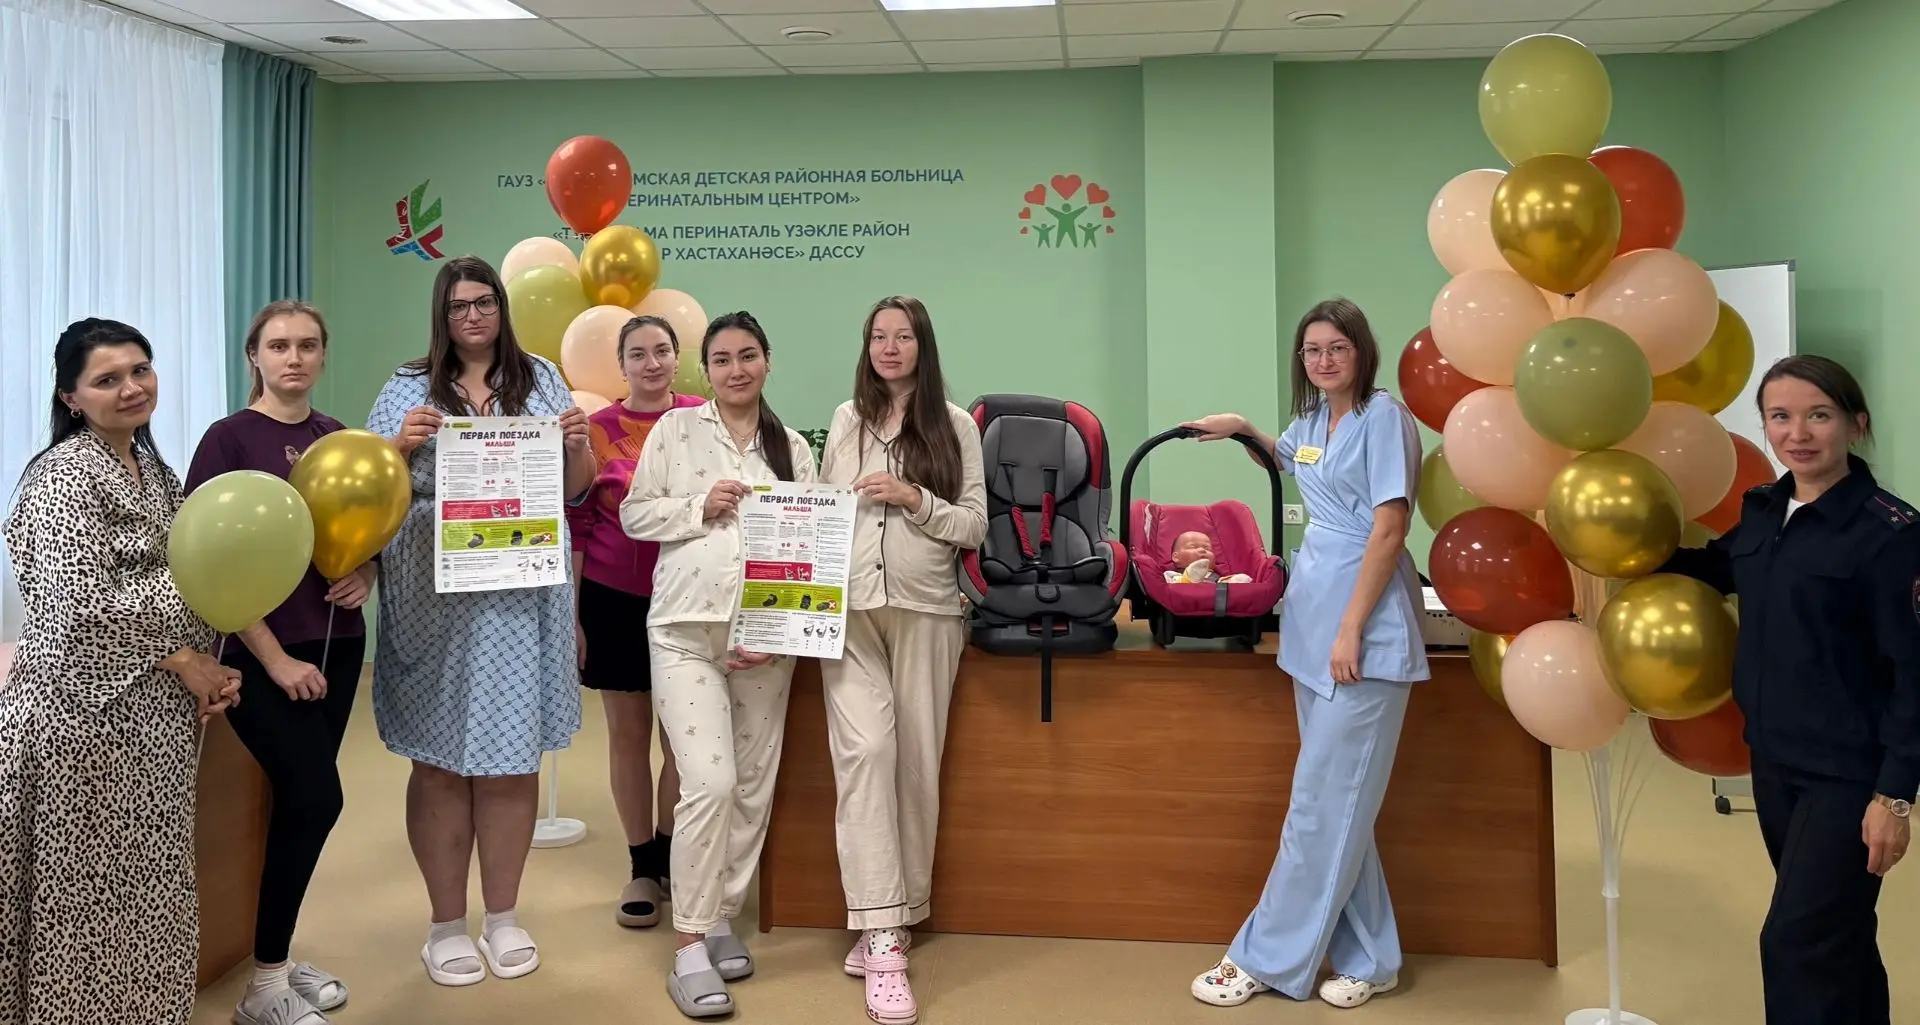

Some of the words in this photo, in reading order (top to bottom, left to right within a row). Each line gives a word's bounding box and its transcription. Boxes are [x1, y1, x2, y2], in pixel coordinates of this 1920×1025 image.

[498, 175, 533, 187] ГАУЗ
[633, 172, 690, 185] МСКАЯ
[694, 171, 770, 187] ДЕТСКАЯ
[775, 168, 866, 184] РАЙОННАЯ
[871, 169, 964, 184] БОЛЬНИЦА
[628, 193, 763, 207] ЕРИНАТАЛЬНЫМ
[768, 192, 861, 207] ЦЕНТРОМ»
[643, 226, 668, 239] МА
[673, 225, 781, 239] ПЕРИНАТАЛЬ
[785, 224, 848, 238] ҮЗӘКЛЕ
[852, 220, 910, 236] РАЙОН
[675, 246, 805, 260] ХАСТАХАНӘСЕ»
[809, 245, 865, 261] ДАССУ
[460, 431, 496, 440] ПЕРВАЯ
[499, 431, 541, 440] ПОЕЗДКА
[760, 495, 794, 504] ПЕРВАЯ
[797, 497, 836, 506] ПОЕЗДКА
